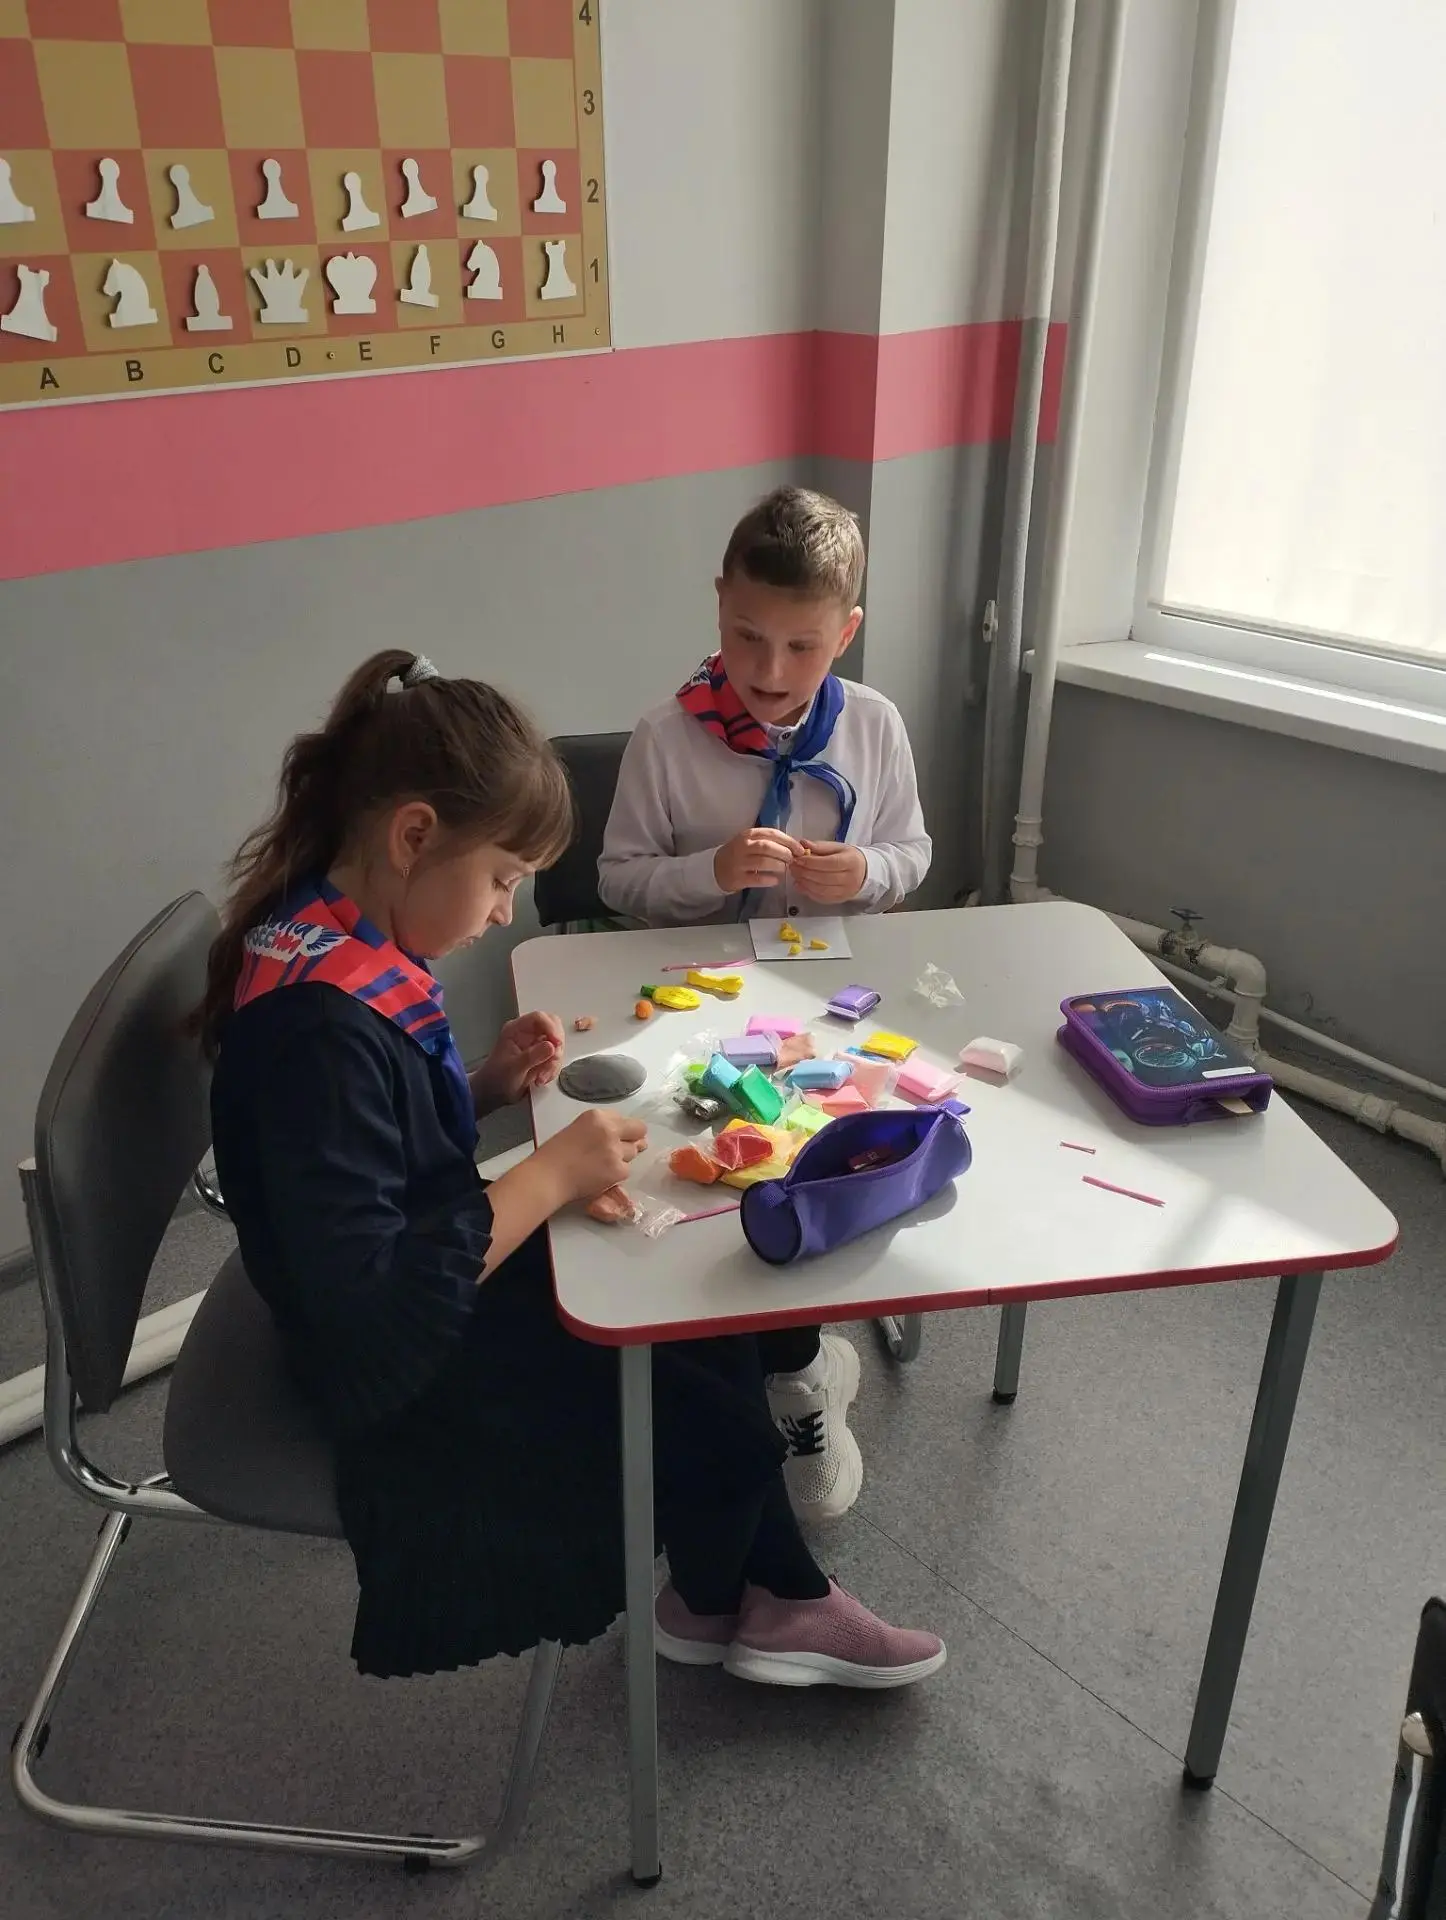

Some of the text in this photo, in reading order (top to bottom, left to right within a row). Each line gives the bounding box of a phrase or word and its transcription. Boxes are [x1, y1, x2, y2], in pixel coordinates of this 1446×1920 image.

[578, 0, 592, 26] 4
[583, 89, 596, 116] 3
[586, 178, 600, 203] 2
[589, 258, 599, 283] 1
[40, 324, 565, 390] A B C D E F G H
